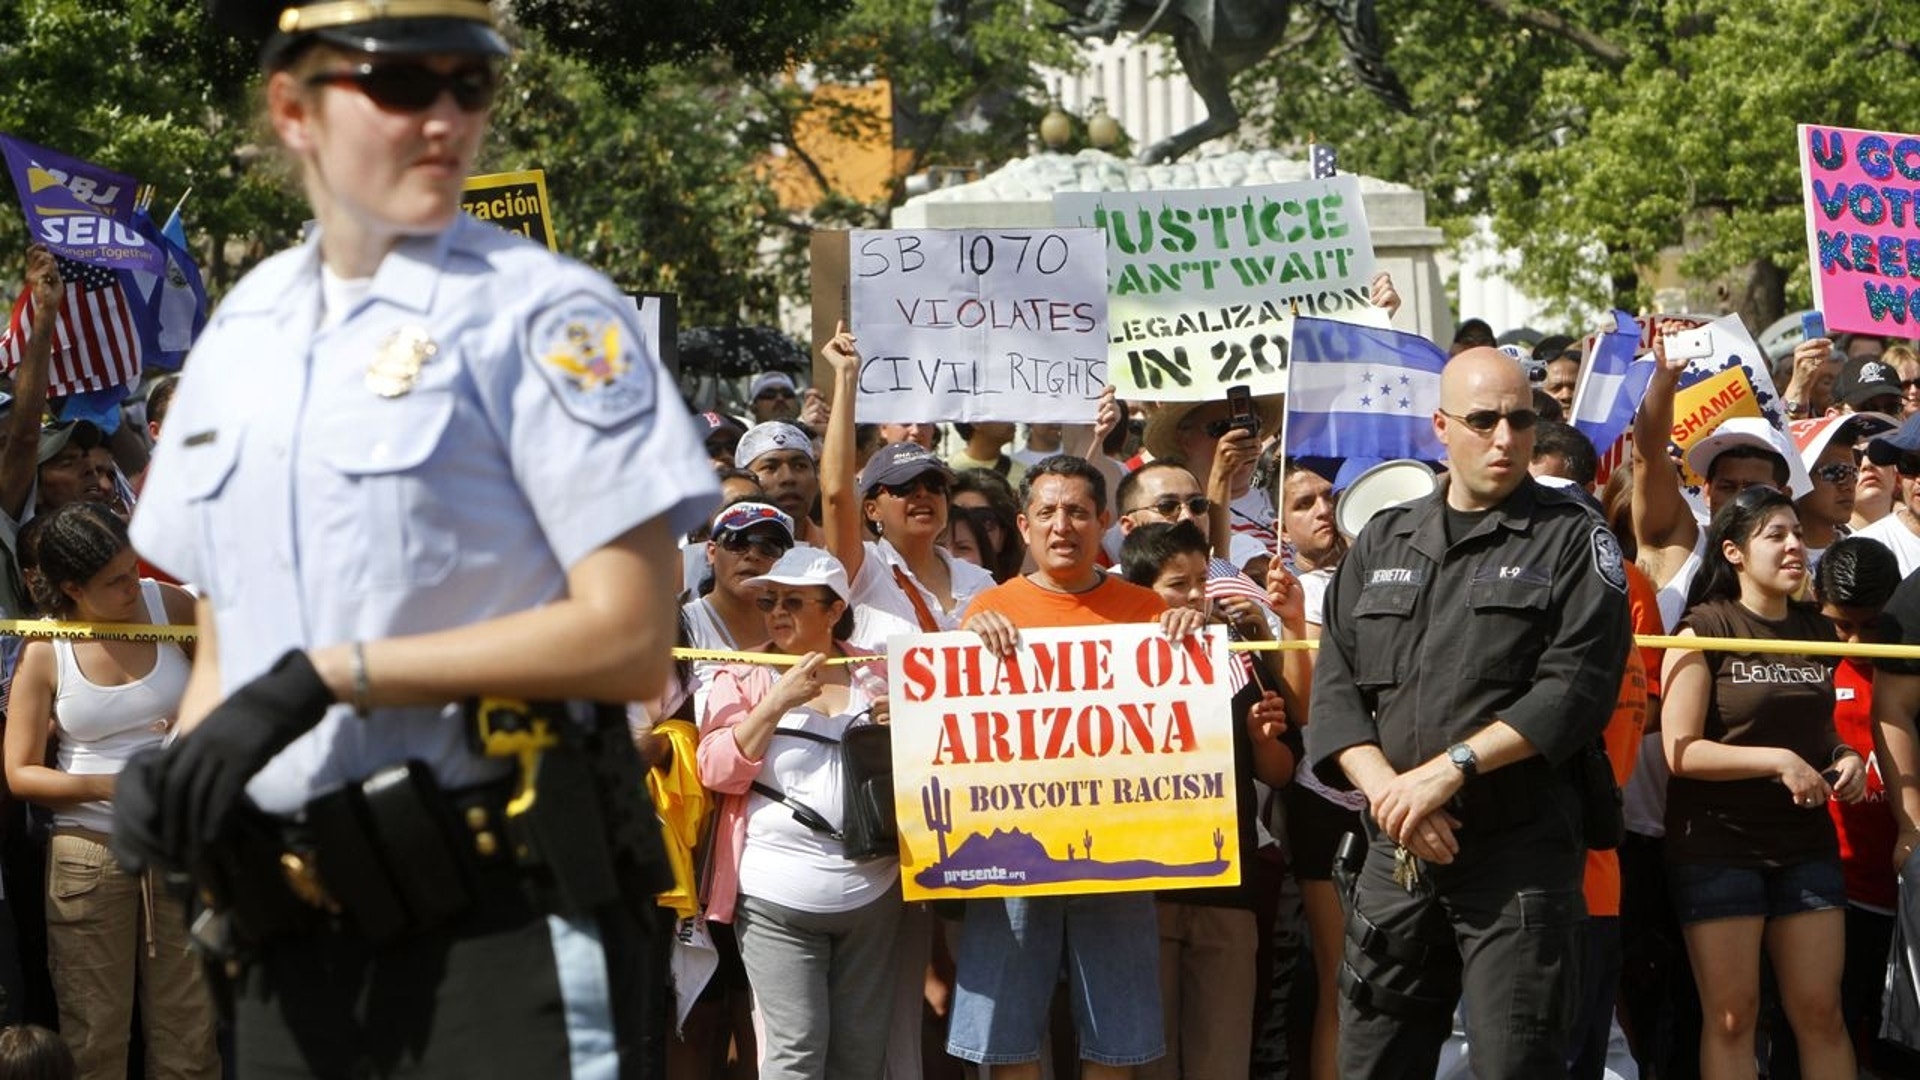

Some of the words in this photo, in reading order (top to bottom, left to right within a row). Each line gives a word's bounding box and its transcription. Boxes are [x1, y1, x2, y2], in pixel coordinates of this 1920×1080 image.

[1811, 129, 1844, 171] U
[1813, 179, 1920, 228] VOT
[40, 216, 145, 247] SEIU
[858, 236, 925, 277] SB
[960, 234, 1069, 275] 1070
[1106, 259, 1221, 296] AN'T
[1230, 247, 1354, 287] WAIT
[897, 298, 1096, 333] VIOLATES
[1864, 280, 1920, 324] W
[859, 356, 1002, 395] CIVIL
[1007, 352, 1107, 400] RIGHTS
[1127, 346, 1192, 389] IN
[1671, 380, 1748, 442] SHAME
[1500, 566, 1520, 578] K-9
[903, 639, 1115, 702] SHAME
[1135, 634, 1217, 688] ON
[931, 700, 1200, 766] ARIZONA
[969, 778, 1102, 813] BOYCOTT
[1113, 772, 1225, 806] RACISM
[944, 866, 1026, 884] presente.org
